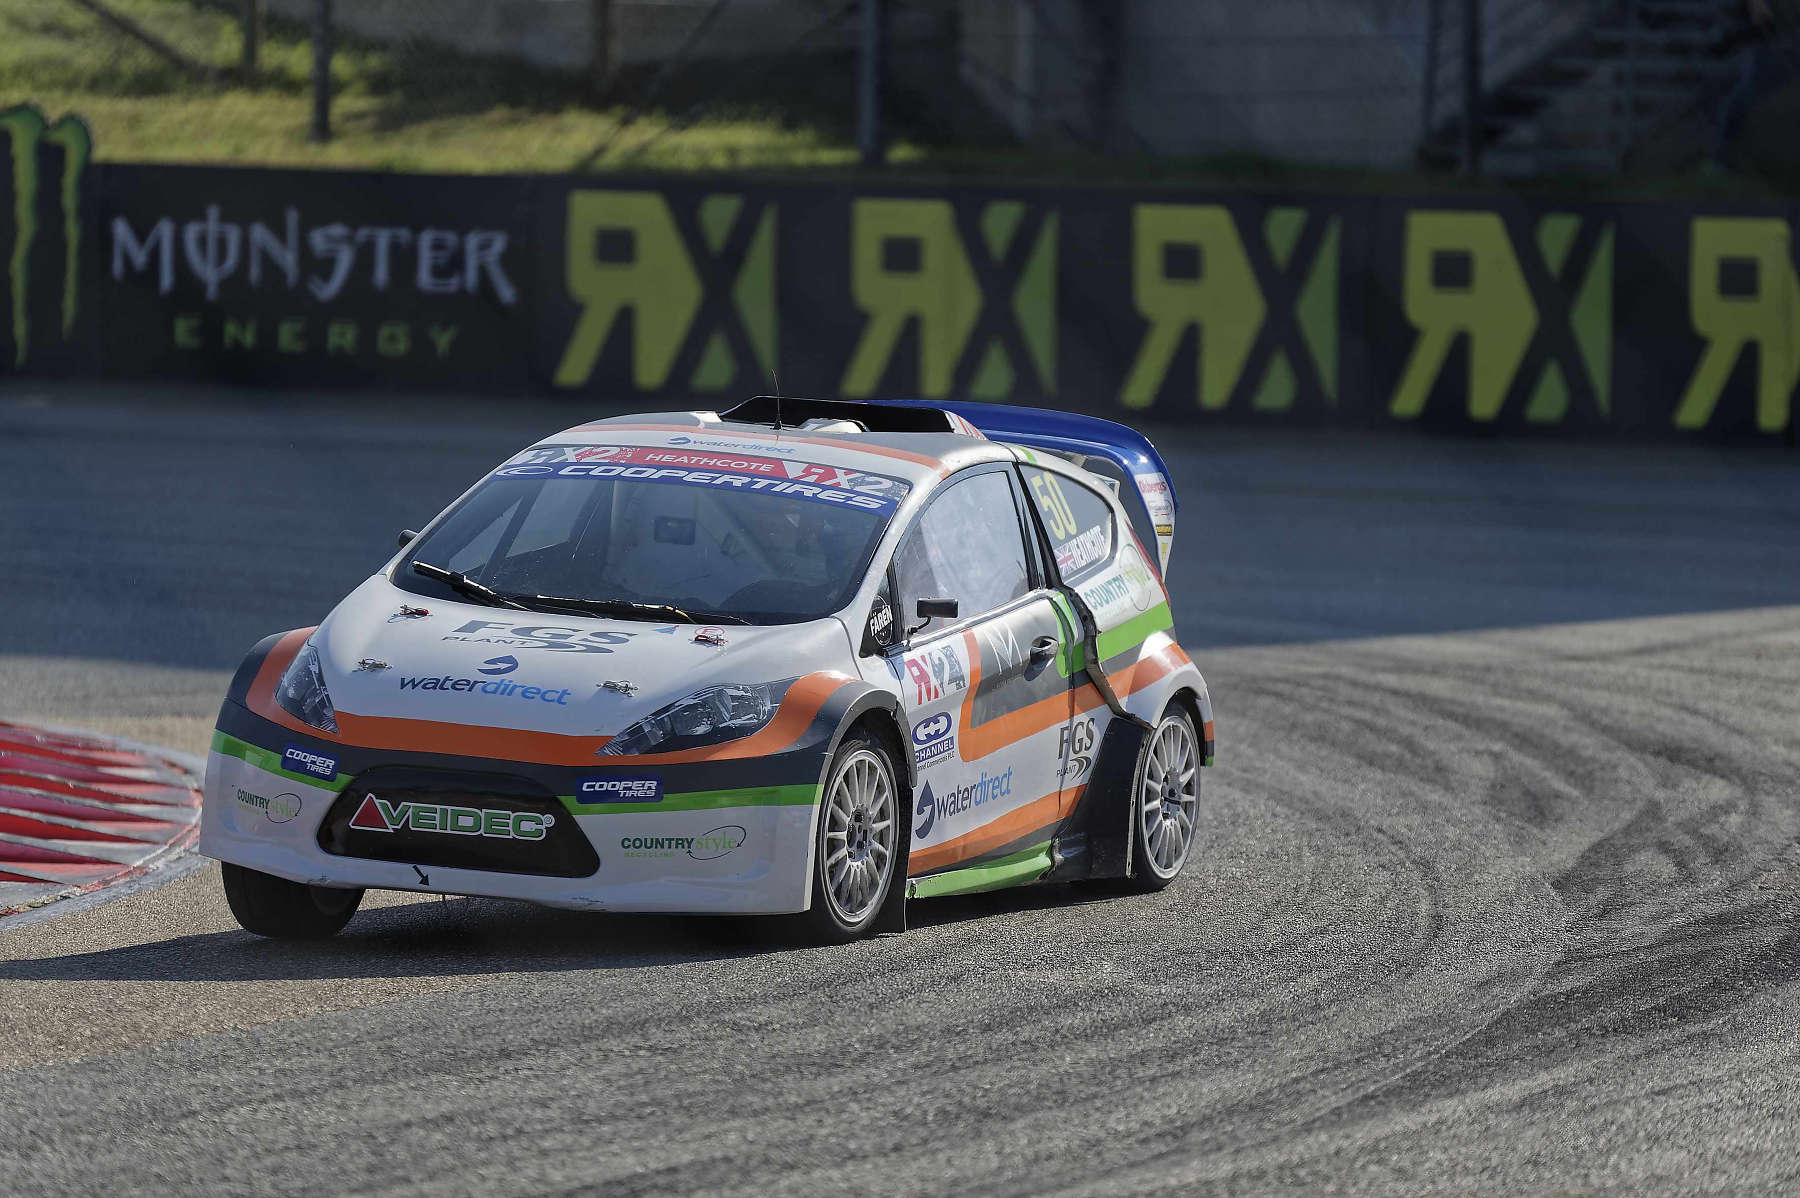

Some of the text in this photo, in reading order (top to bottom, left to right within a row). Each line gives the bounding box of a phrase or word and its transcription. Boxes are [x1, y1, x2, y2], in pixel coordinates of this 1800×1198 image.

[111, 203, 517, 305] MONSTER
[172, 315, 456, 356] ENERGY
[645, 452, 774, 472] HEATHCOTE
[1031, 470, 1077, 540] 50
[1083, 574, 1130, 611] COUNTRY
[441, 635, 530, 646] PLANT
[452, 619, 638, 645] FGS
[399, 675, 571, 705] waterdirect
[1058, 717, 1095, 760] FGS
[285, 748, 335, 769] COOPER
[306, 763, 333, 776] TIRES
[582, 780, 657, 792] COOPER
[618, 789, 656, 797] TIRES
[936, 765, 1013, 821] waterdirect
